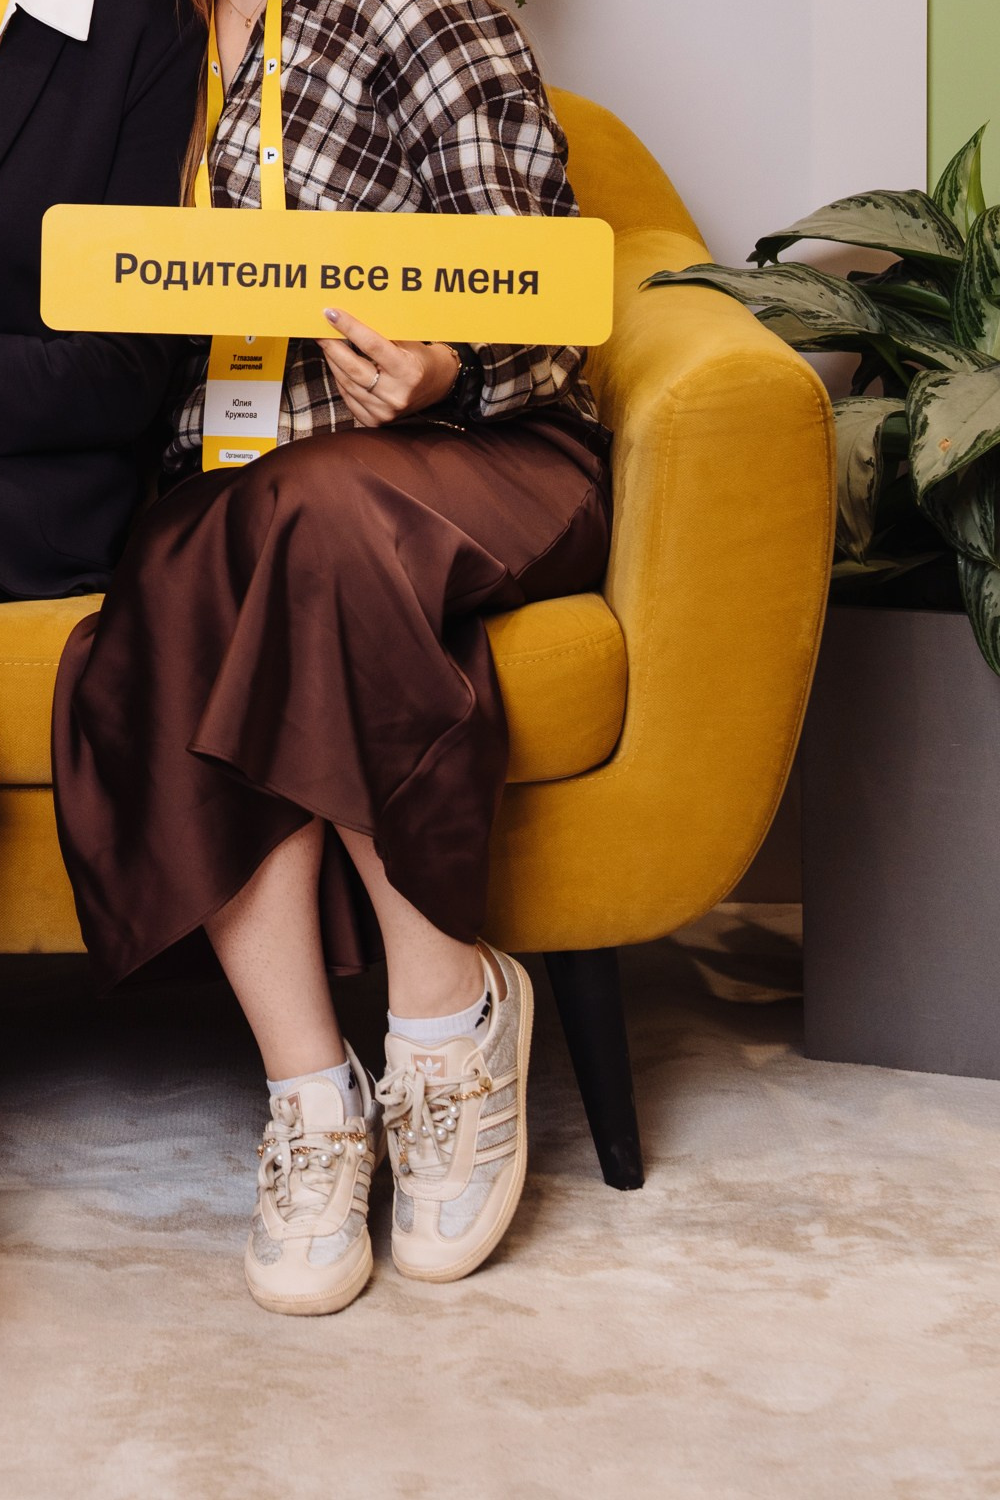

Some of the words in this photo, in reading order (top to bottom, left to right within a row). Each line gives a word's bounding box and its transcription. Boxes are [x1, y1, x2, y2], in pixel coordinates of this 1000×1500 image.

[115, 252, 308, 291] Родители
[320, 264, 389, 292] все
[401, 266, 423, 292] в
[434, 267, 539, 296] меня
[237, 354, 263, 362] глазами
[230, 362, 263, 371] родителей
[232, 398, 252, 407] Юлия
[225, 410, 258, 420] Кружкова
[225, 451, 254, 461] Организатор
